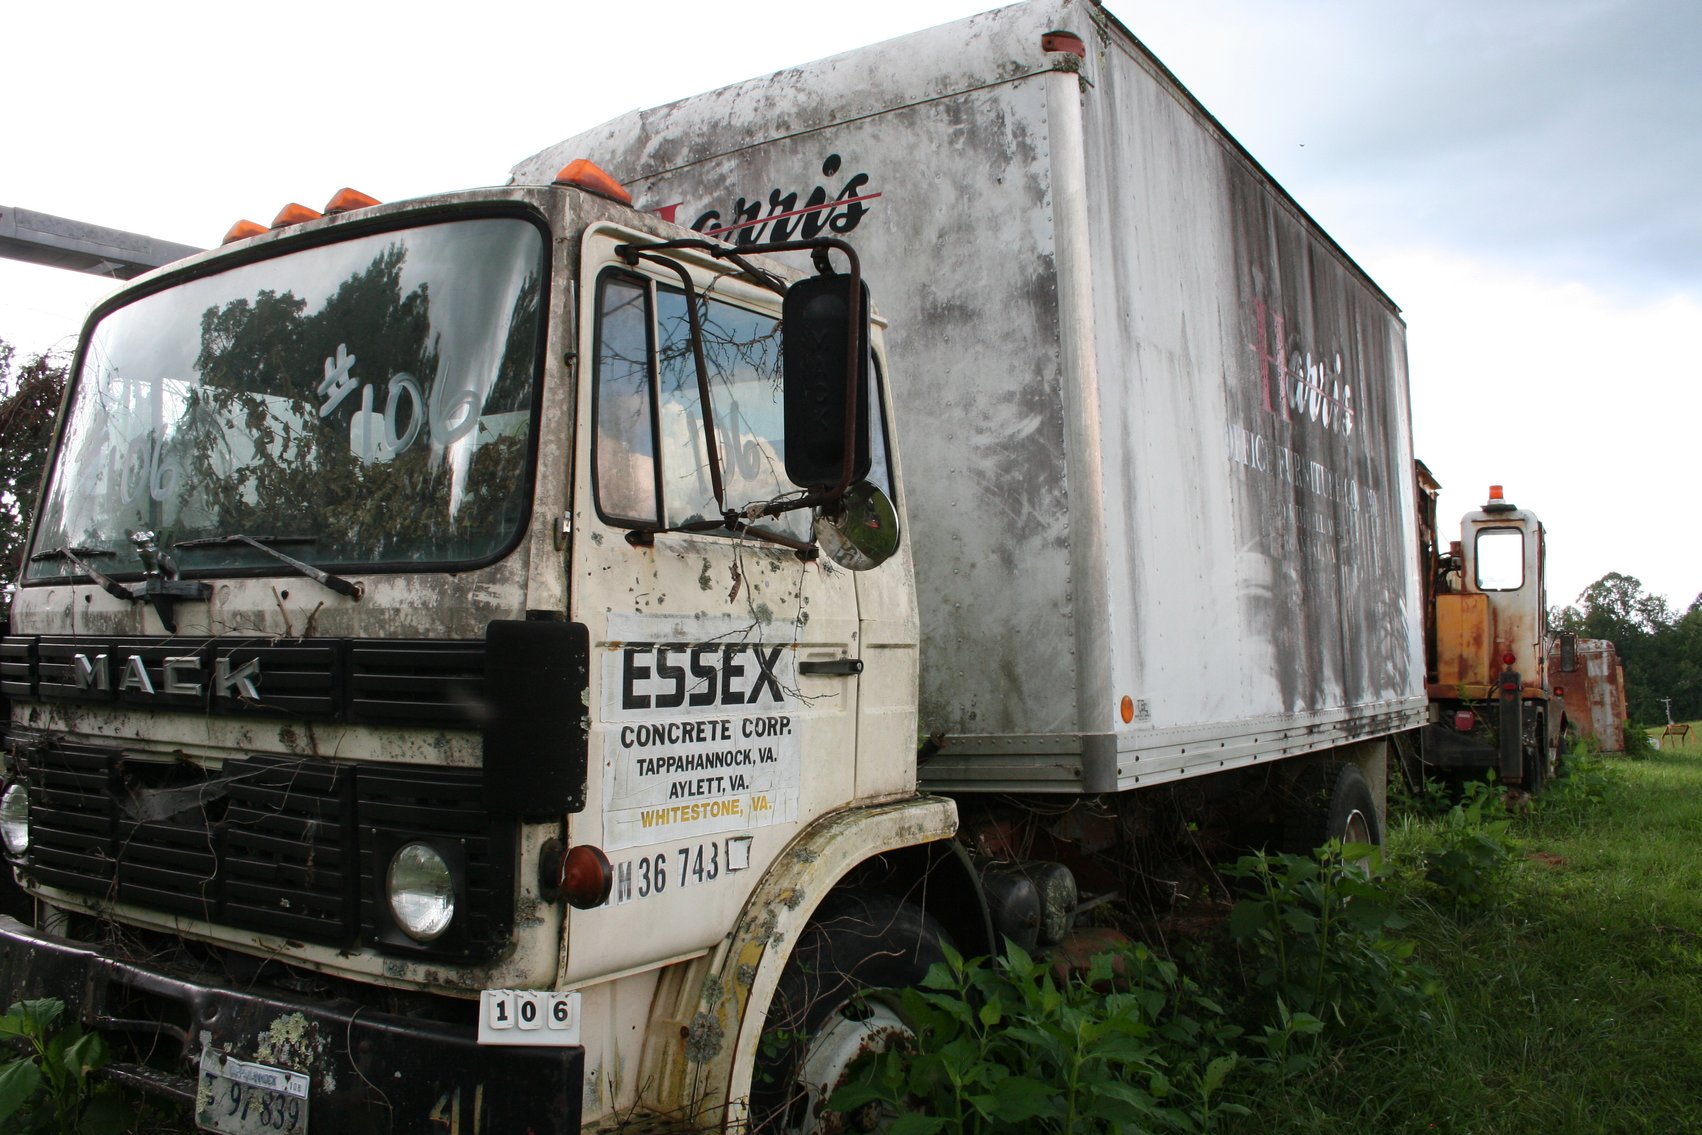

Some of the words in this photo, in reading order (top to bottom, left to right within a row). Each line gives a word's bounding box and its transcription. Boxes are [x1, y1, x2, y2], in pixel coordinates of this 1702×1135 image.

[652, 153, 876, 246] arris
[317, 343, 481, 466] #106
[74, 653, 261, 700] MACK
[621, 641, 791, 710] ESSEX
[620, 719, 731, 749] CONCRETE
[741, 716, 792, 738] CORP.
[636, 749, 756, 776] TAPPAHANNOCK,
[758, 747, 778, 763] VA.
[669, 776, 726, 799] AYLETT,
[729, 774, 750, 791] VA.
[640, 799, 744, 828] WHITESTONE,
[751, 796, 773, 811] VA.
[678, 841, 719, 888] 743
[495, 998, 569, 1023] 106
